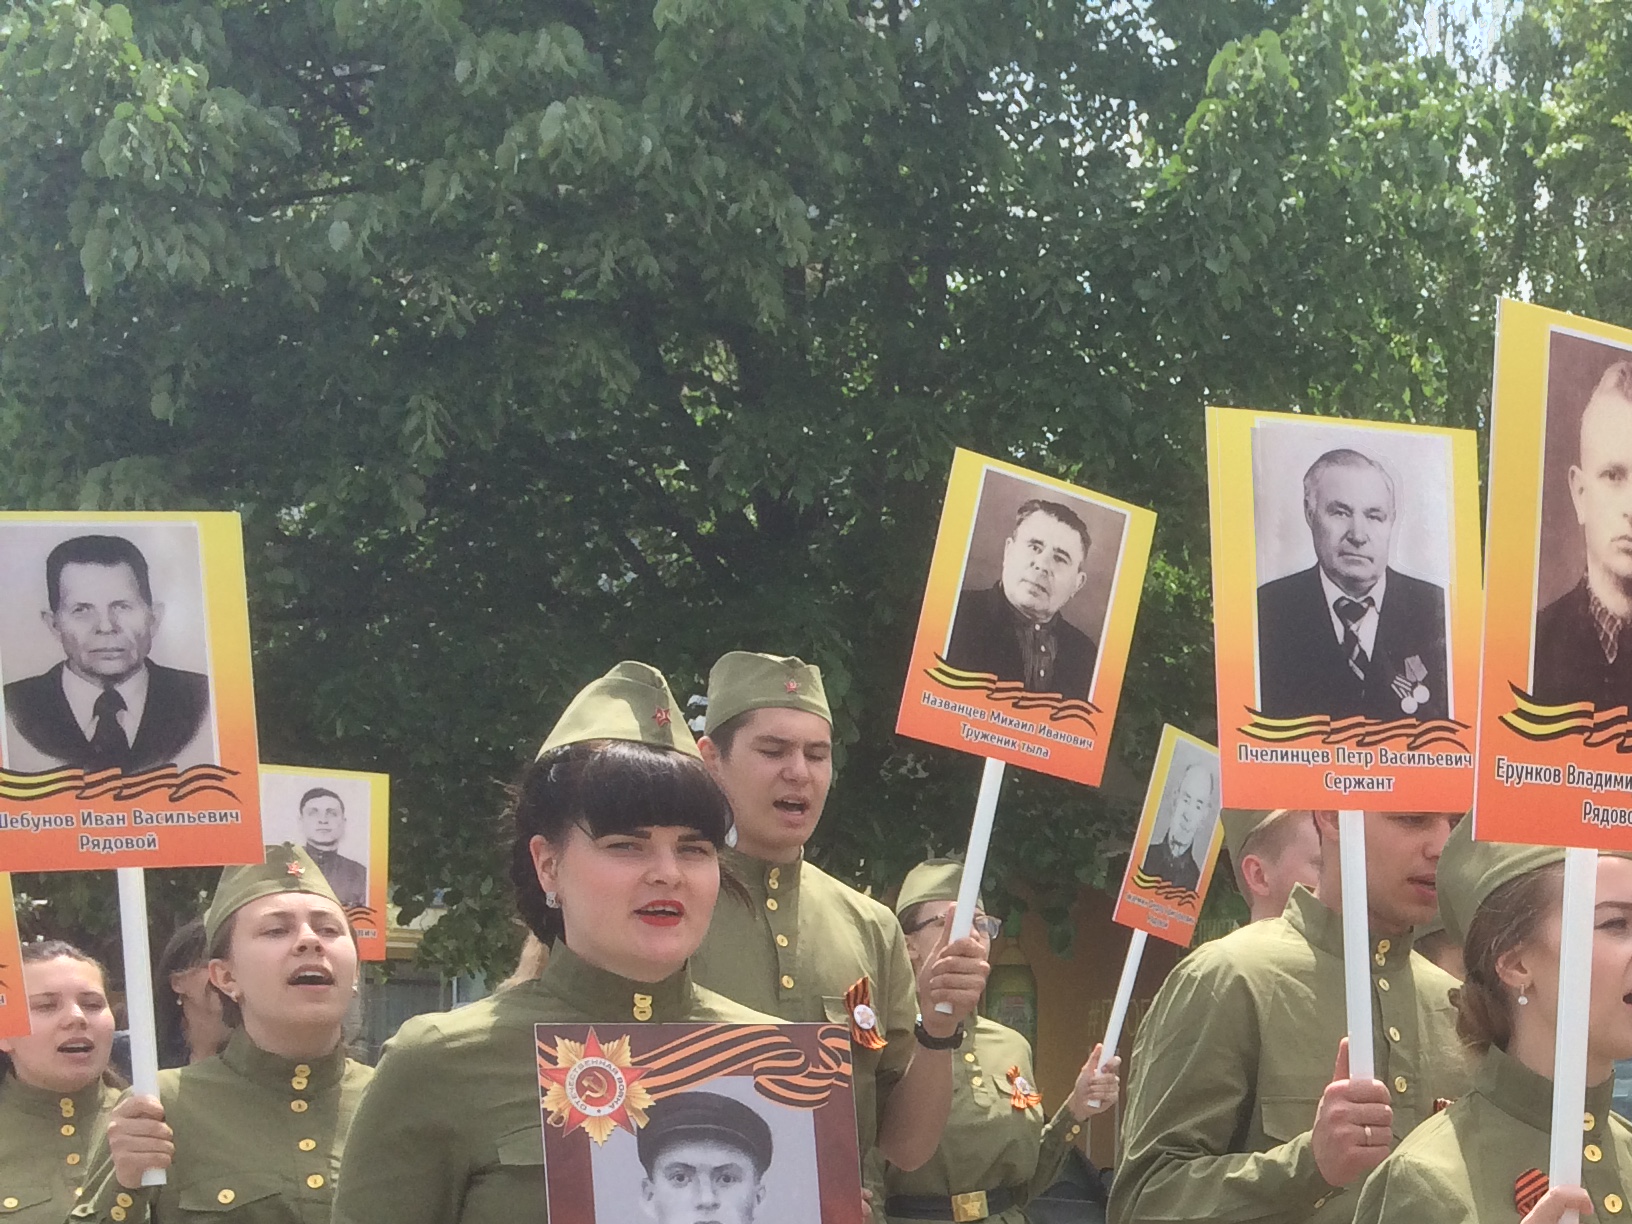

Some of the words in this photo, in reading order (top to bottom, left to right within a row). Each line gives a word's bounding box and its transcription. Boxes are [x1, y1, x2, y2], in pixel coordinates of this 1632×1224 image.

[921, 691, 986, 720] Названцев
[989, 711, 1035, 733] Михаил
[1038, 723, 1094, 749] Иванович
[960, 722, 1017, 749] Труженик
[1021, 743, 1050, 758] тыла
[1238, 744, 1330, 765] Пчелинцев
[1336, 747, 1373, 767] Петр
[1379, 748, 1472, 767] Васильевич
[1324, 772, 1393, 792] Сержант
[1496, 757, 1561, 785] Ерунков
[81, 811, 126, 826] Иван
[133, 809, 240, 825] Васильевич
[80, 834, 157, 852] Рядовой
